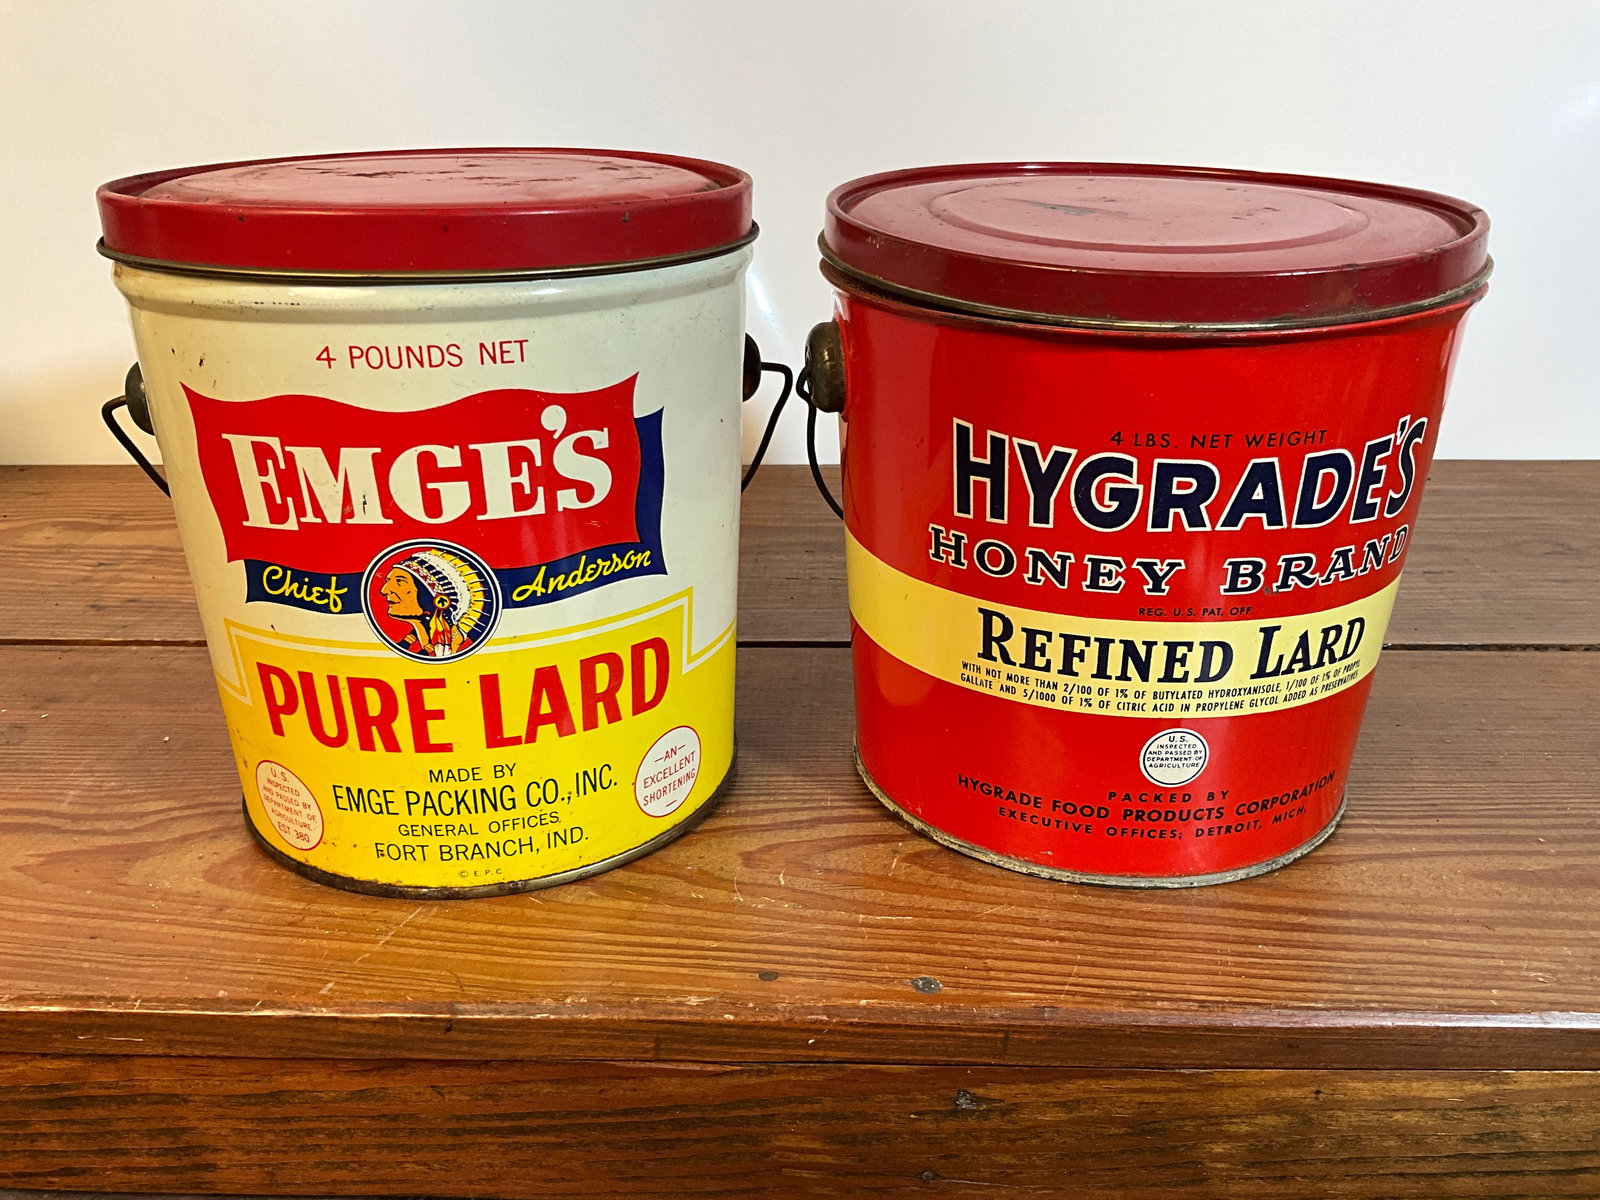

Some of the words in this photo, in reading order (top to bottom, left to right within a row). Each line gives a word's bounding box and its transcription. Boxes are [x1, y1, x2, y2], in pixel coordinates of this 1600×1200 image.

[315, 345, 337, 369] 4
[349, 343, 463, 370] POUNDS
[479, 339, 529, 366] NET
[1110, 431, 1124, 446] 4
[1133, 433, 1178, 449] LBS.
[1190, 433, 1233, 449] NET
[1245, 429, 1328, 448] WEIGHT
[221, 404, 613, 532] EMGE'S
[952, 414, 1429, 534] HYGRADE'S
[928, 523, 1186, 596] HONEY
[1220, 524, 1410, 596] BRAND
[262, 565, 348, 613] Chief
[512, 548, 653, 602] Anderson
[1138, 607, 1166, 617] REG.
[1202, 607, 1224, 617] PAT.
[977, 607, 1234, 683] REFINED
[1249, 617, 1366, 681] LARD
[256, 661, 454, 754] PURE
[478, 636, 670, 750] LARD
[960, 672, 993, 690] GALLATE
[999, 683, 1017, 695] AND
[1023, 688, 1056, 703] 5/1000
[1061, 695, 1074, 705] OF
[1079, 698, 1092, 708] 1%
[1098, 700, 1111, 709] OF
[1116, 701, 1146, 712] CITRIC
[1152, 702, 1175, 712] ACID
[1180, 703, 1191, 712] IN
[1195, 699, 1244, 712] PROPYLENE
[1249, 695, 1279, 708] GLYCOL
[1282, 689, 1306, 703] ADDED
[1309, 686, 1318, 696] AS
[1320, 669, 1359, 692] PRESERVATIVES
[961, 660, 981, 674] WITH
[985, 667, 1002, 680] NOT
[1006, 672, 1030, 686] MORE
[1035, 678, 1059, 691] THAN
[1063, 683, 1092, 696] 2/100
[1097, 687, 1110, 697] OF
[1115, 688, 1128, 699] 1%
[1134, 690, 1147, 700] OF
[1152, 690, 1203, 700] BUTYLATED
[1208, 682, 1282, 699] HYDROXYANISOLE,
[1286, 677, 1307, 692] 1/100
[1310, 675, 1320, 685] OF
[1322, 671, 1331, 681] 1%
[1333, 667, 1341, 678] OF
[429, 767, 482, 783] MADE
[493, 762, 517, 779] BY
[643, 750, 696, 789] EXCELLENT
[267, 778, 300, 797] INSPECTED
[332, 784, 399, 815] EMGE
[405, 784, 517, 816] PACKING
[643, 768, 696, 807] SHORTENING
[957, 774, 1043, 809] HYGRADE
[1051, 799, 1110, 819] FOOD
[1122, 806, 1225, 823] PRODUCTS
[1235, 770, 1336, 816] CORPORATION
[1107, 791, 1192, 803] PACKED
[1206, 790, 1230, 802] BY
[271, 808, 312, 831] AGRICULTURE
[302, 802, 312, 811] BY
[998, 806, 1093, 834] EXECUTIVE
[1105, 826, 1183, 840] OFFICES;
[1195, 820, 1263, 838] DETROIT,
[1271, 805, 1307, 825] MICH.
[294, 829, 310, 843] 380
[375, 842, 429, 861] FORT
[439, 836, 540, 861] BRANCH,
[547, 826, 589, 849] IND.
[398, 823, 479, 837] GENERAL
